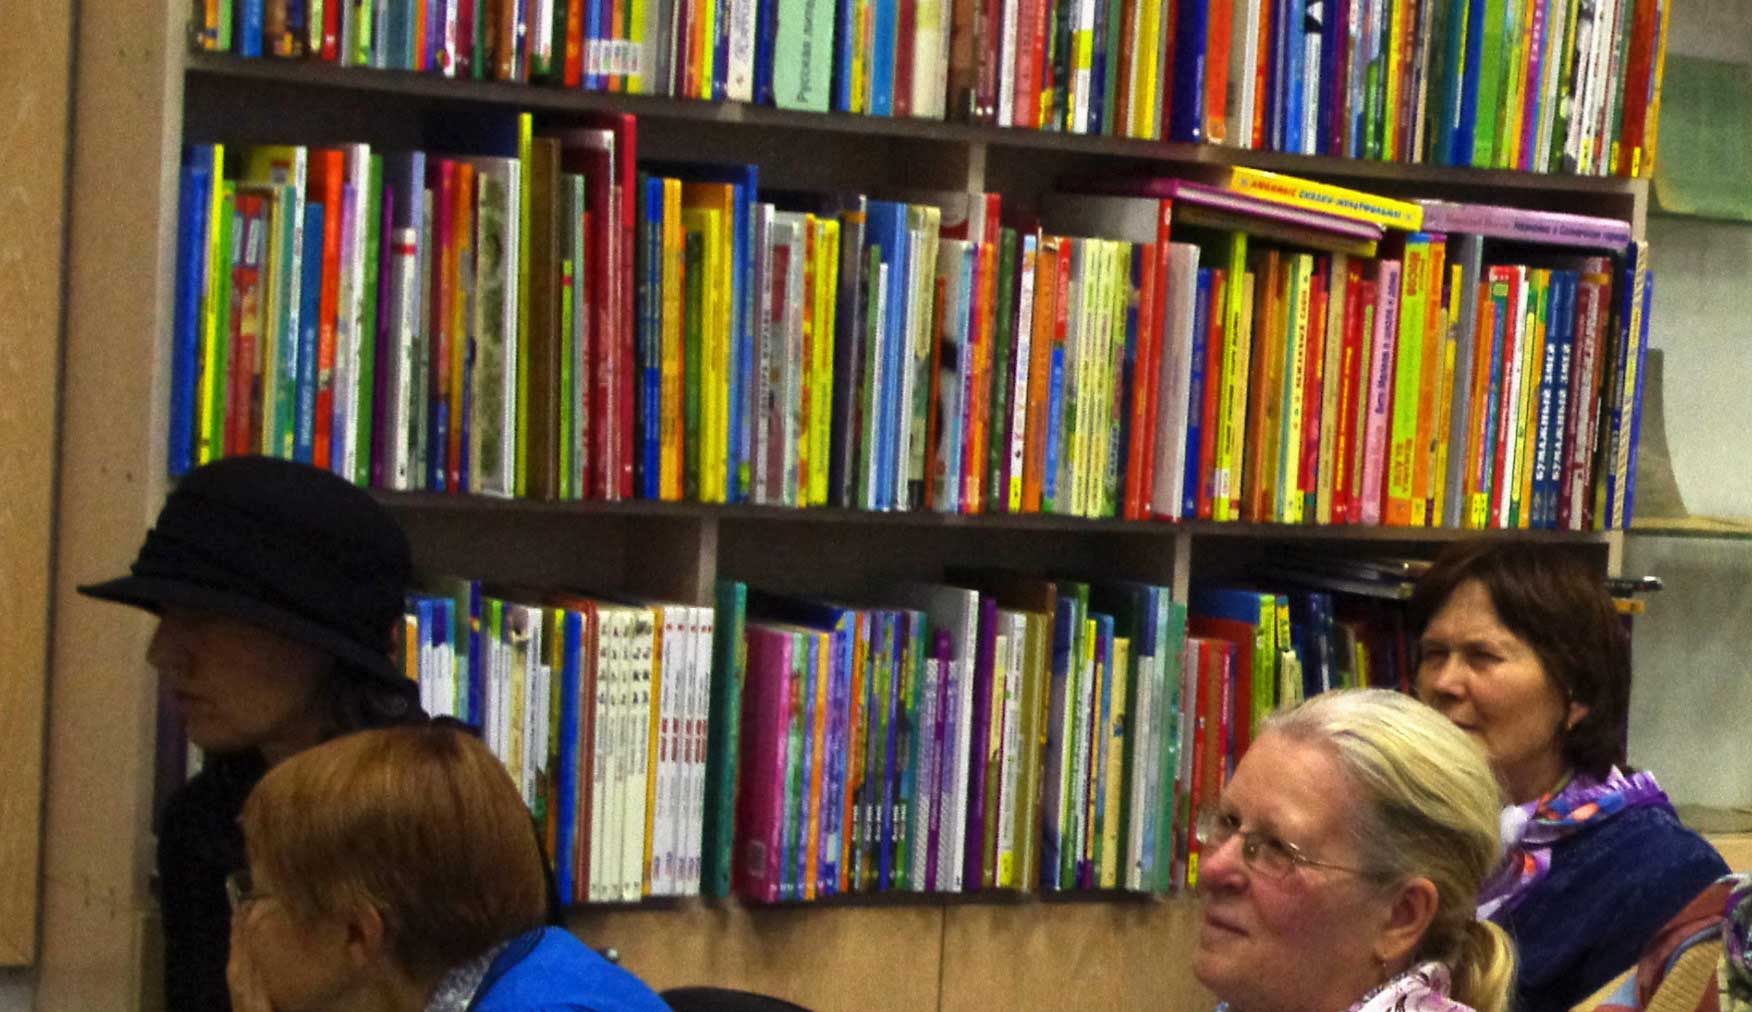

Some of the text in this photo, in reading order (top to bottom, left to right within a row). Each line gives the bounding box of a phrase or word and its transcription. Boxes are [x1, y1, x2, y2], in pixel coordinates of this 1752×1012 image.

[1535, 388, 1552, 482] БУМАЖНЫЙ
[1544, 343, 1556, 385] ЗМЕЙ
[1552, 388, 1567, 482] БУМАЖНЫЙ
[1560, 343, 1572, 385] ЗМЕЙ
